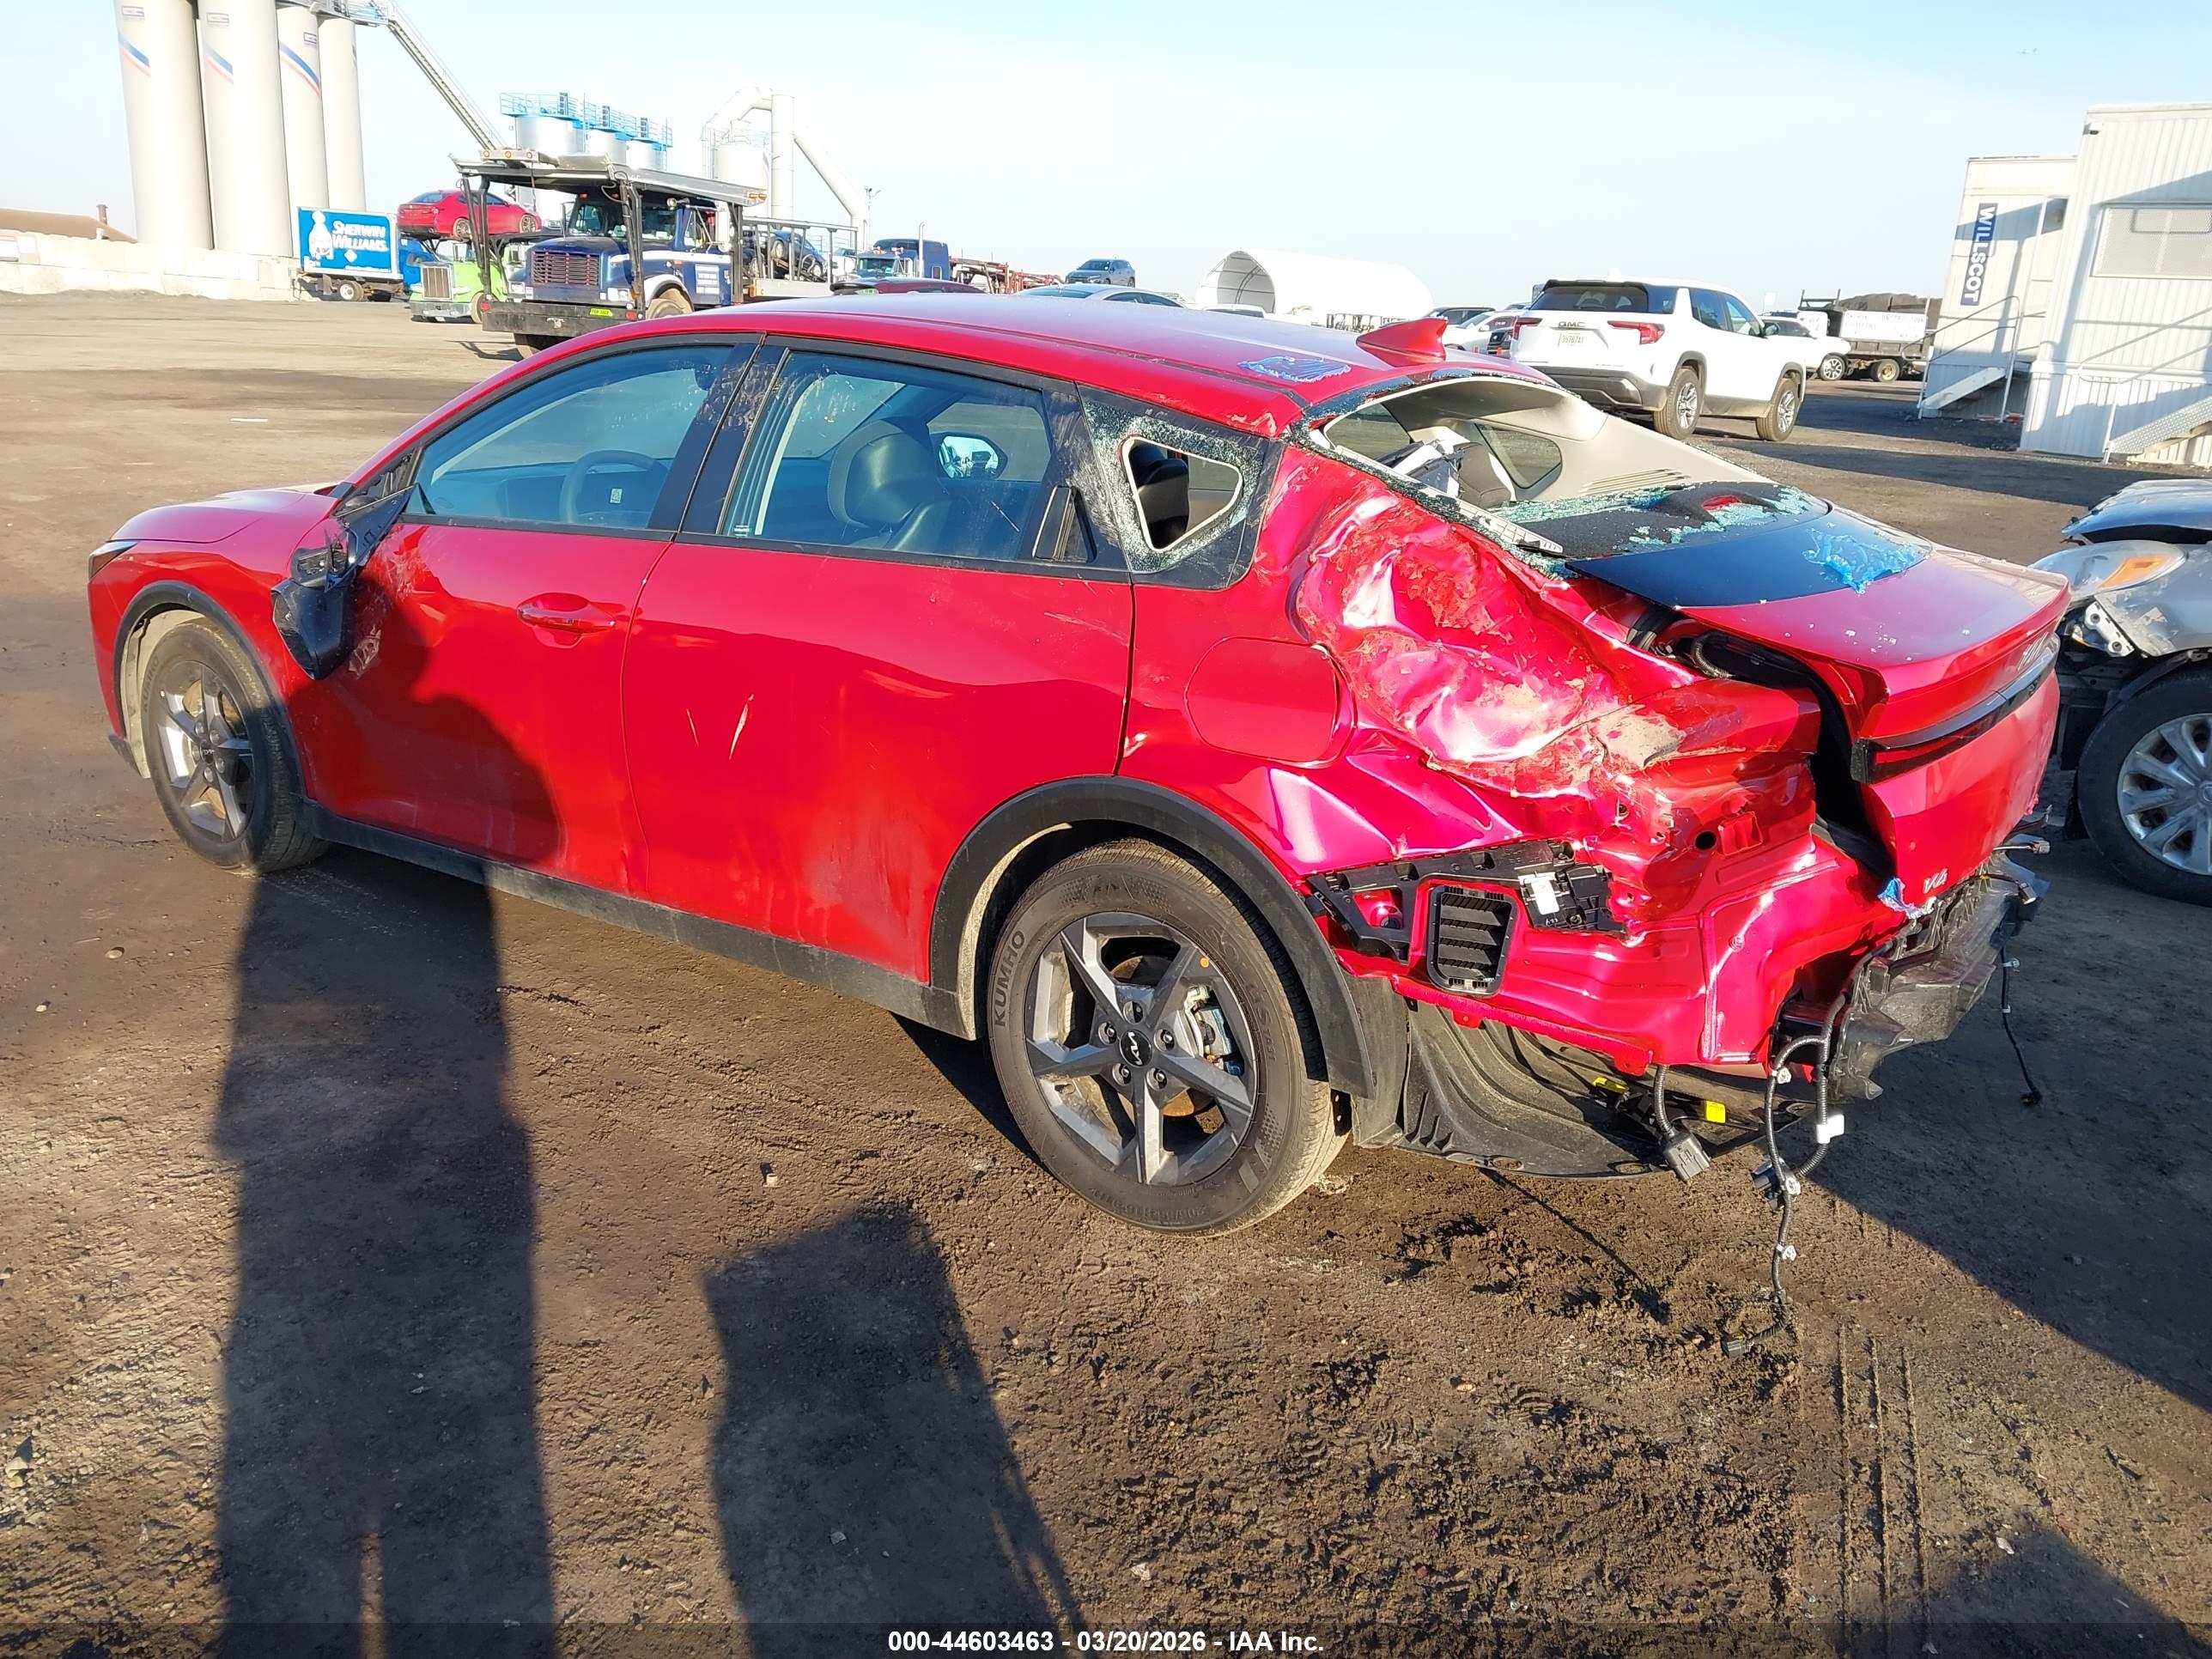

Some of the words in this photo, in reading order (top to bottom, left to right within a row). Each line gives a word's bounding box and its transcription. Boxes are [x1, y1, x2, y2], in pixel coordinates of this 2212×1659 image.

[332, 220, 386, 238] SHERWIN
[1964, 206, 1996, 302] WILLSCOT
[994, 930, 1025, 1027] KUMHO
